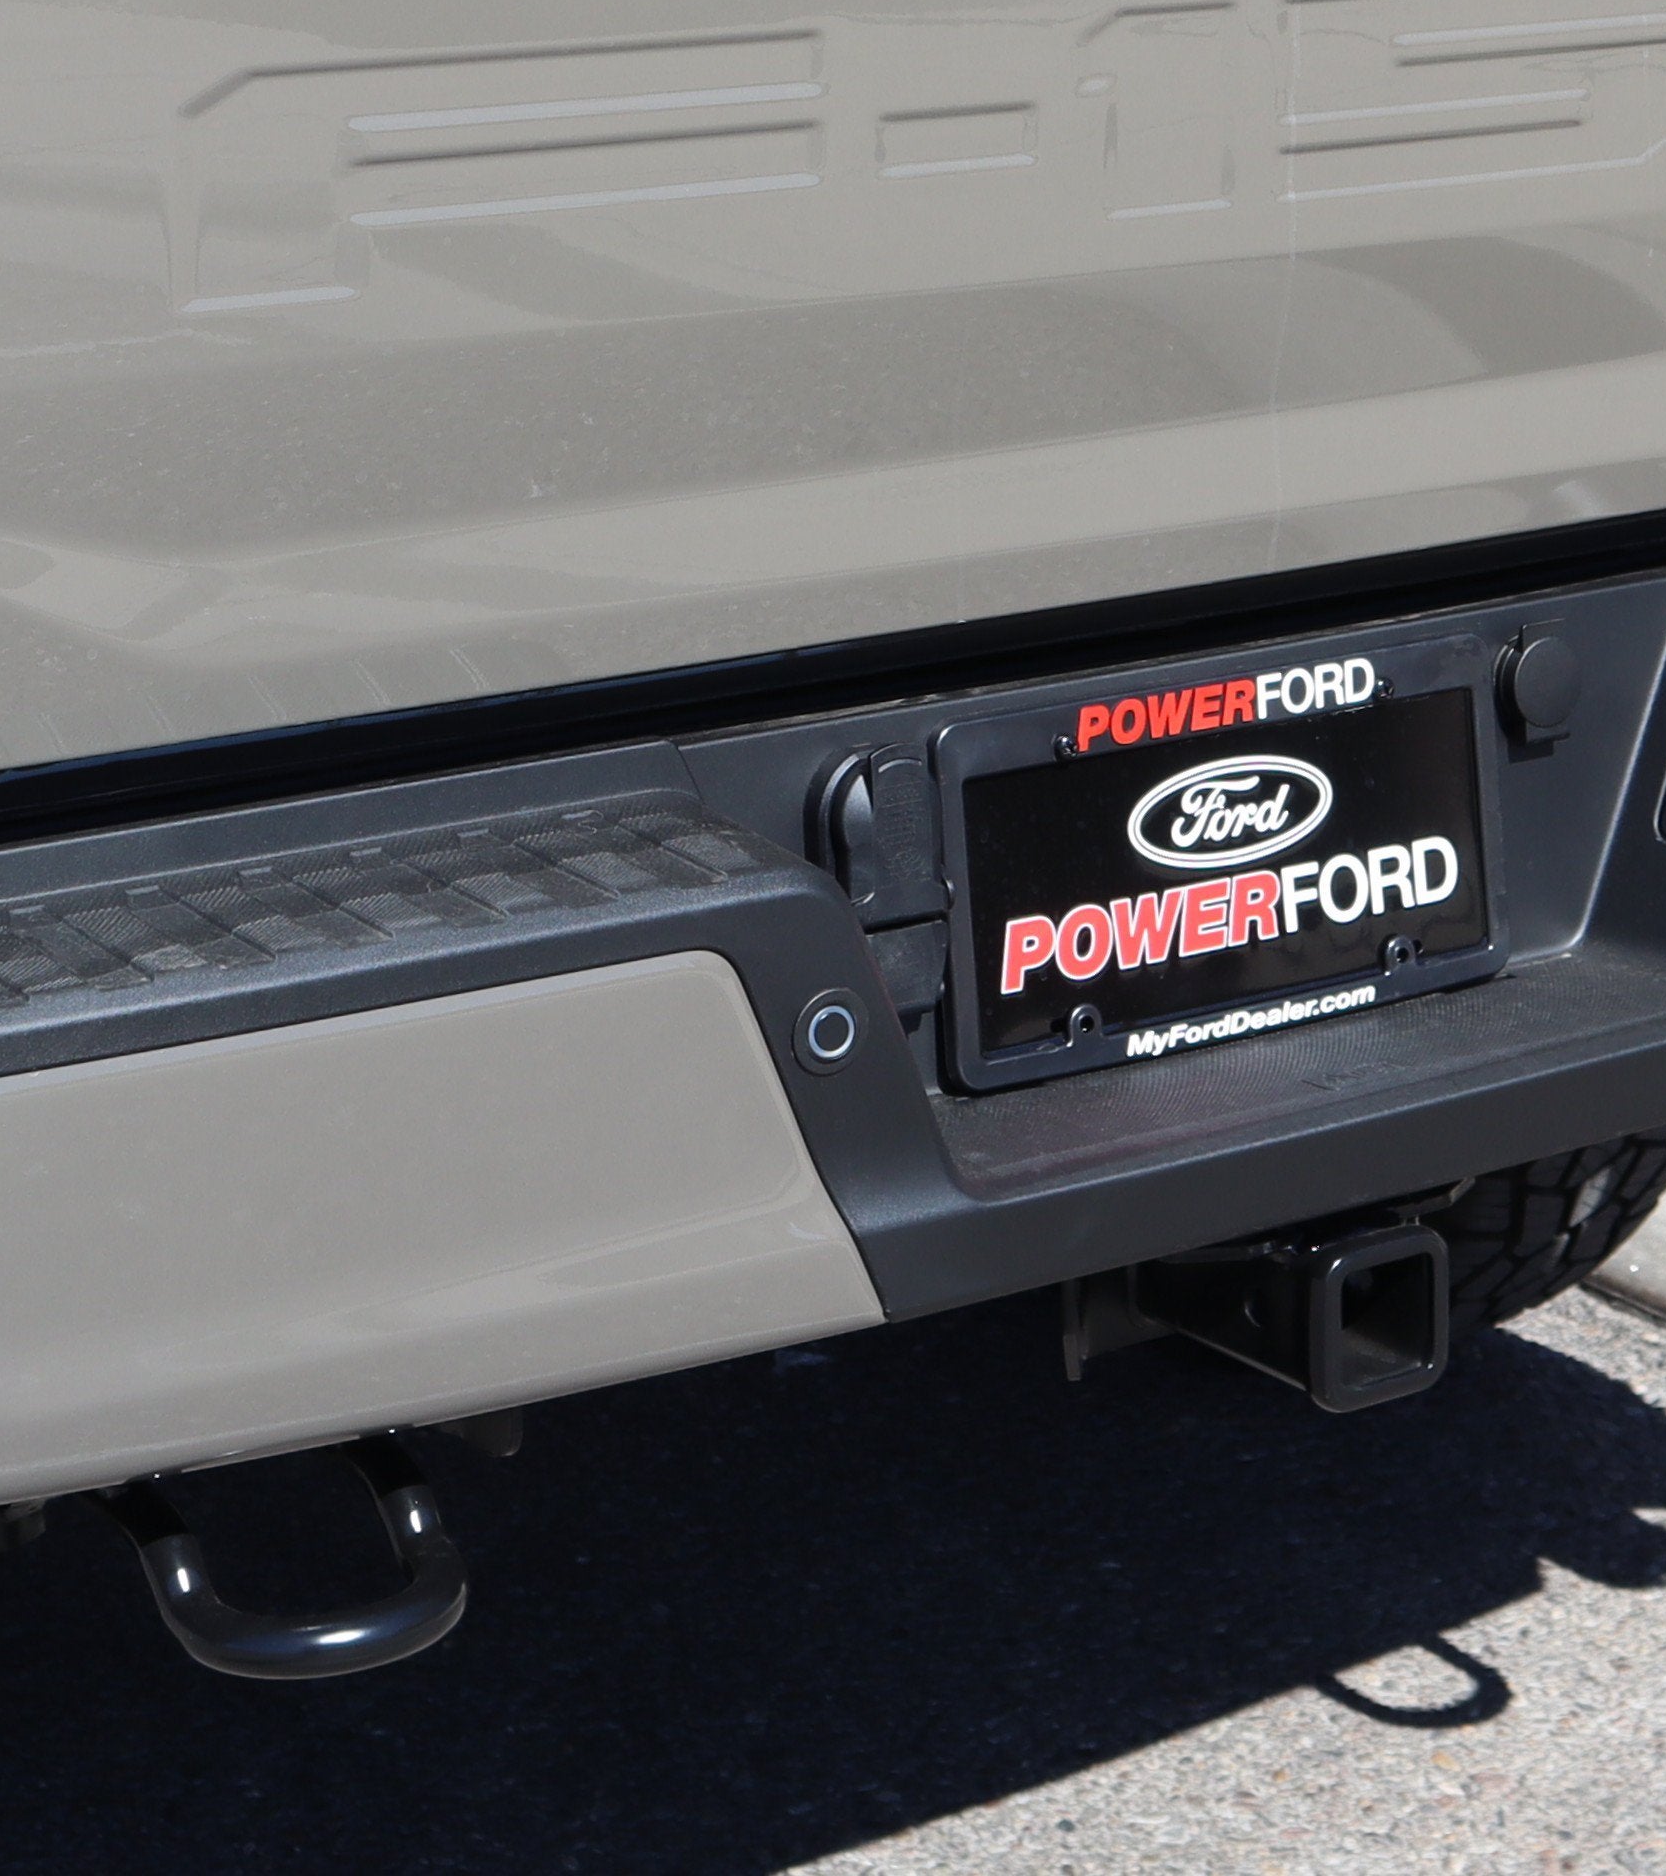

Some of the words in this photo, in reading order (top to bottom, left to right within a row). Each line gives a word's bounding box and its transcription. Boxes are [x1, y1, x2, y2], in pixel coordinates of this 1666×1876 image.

[1077, 657, 1376, 753] POWERFORD
[1171, 776, 1291, 848] Ford
[1000, 835, 1459, 996] POWERFORD
[1126, 983, 1376, 1058] MyFordDealer.com
